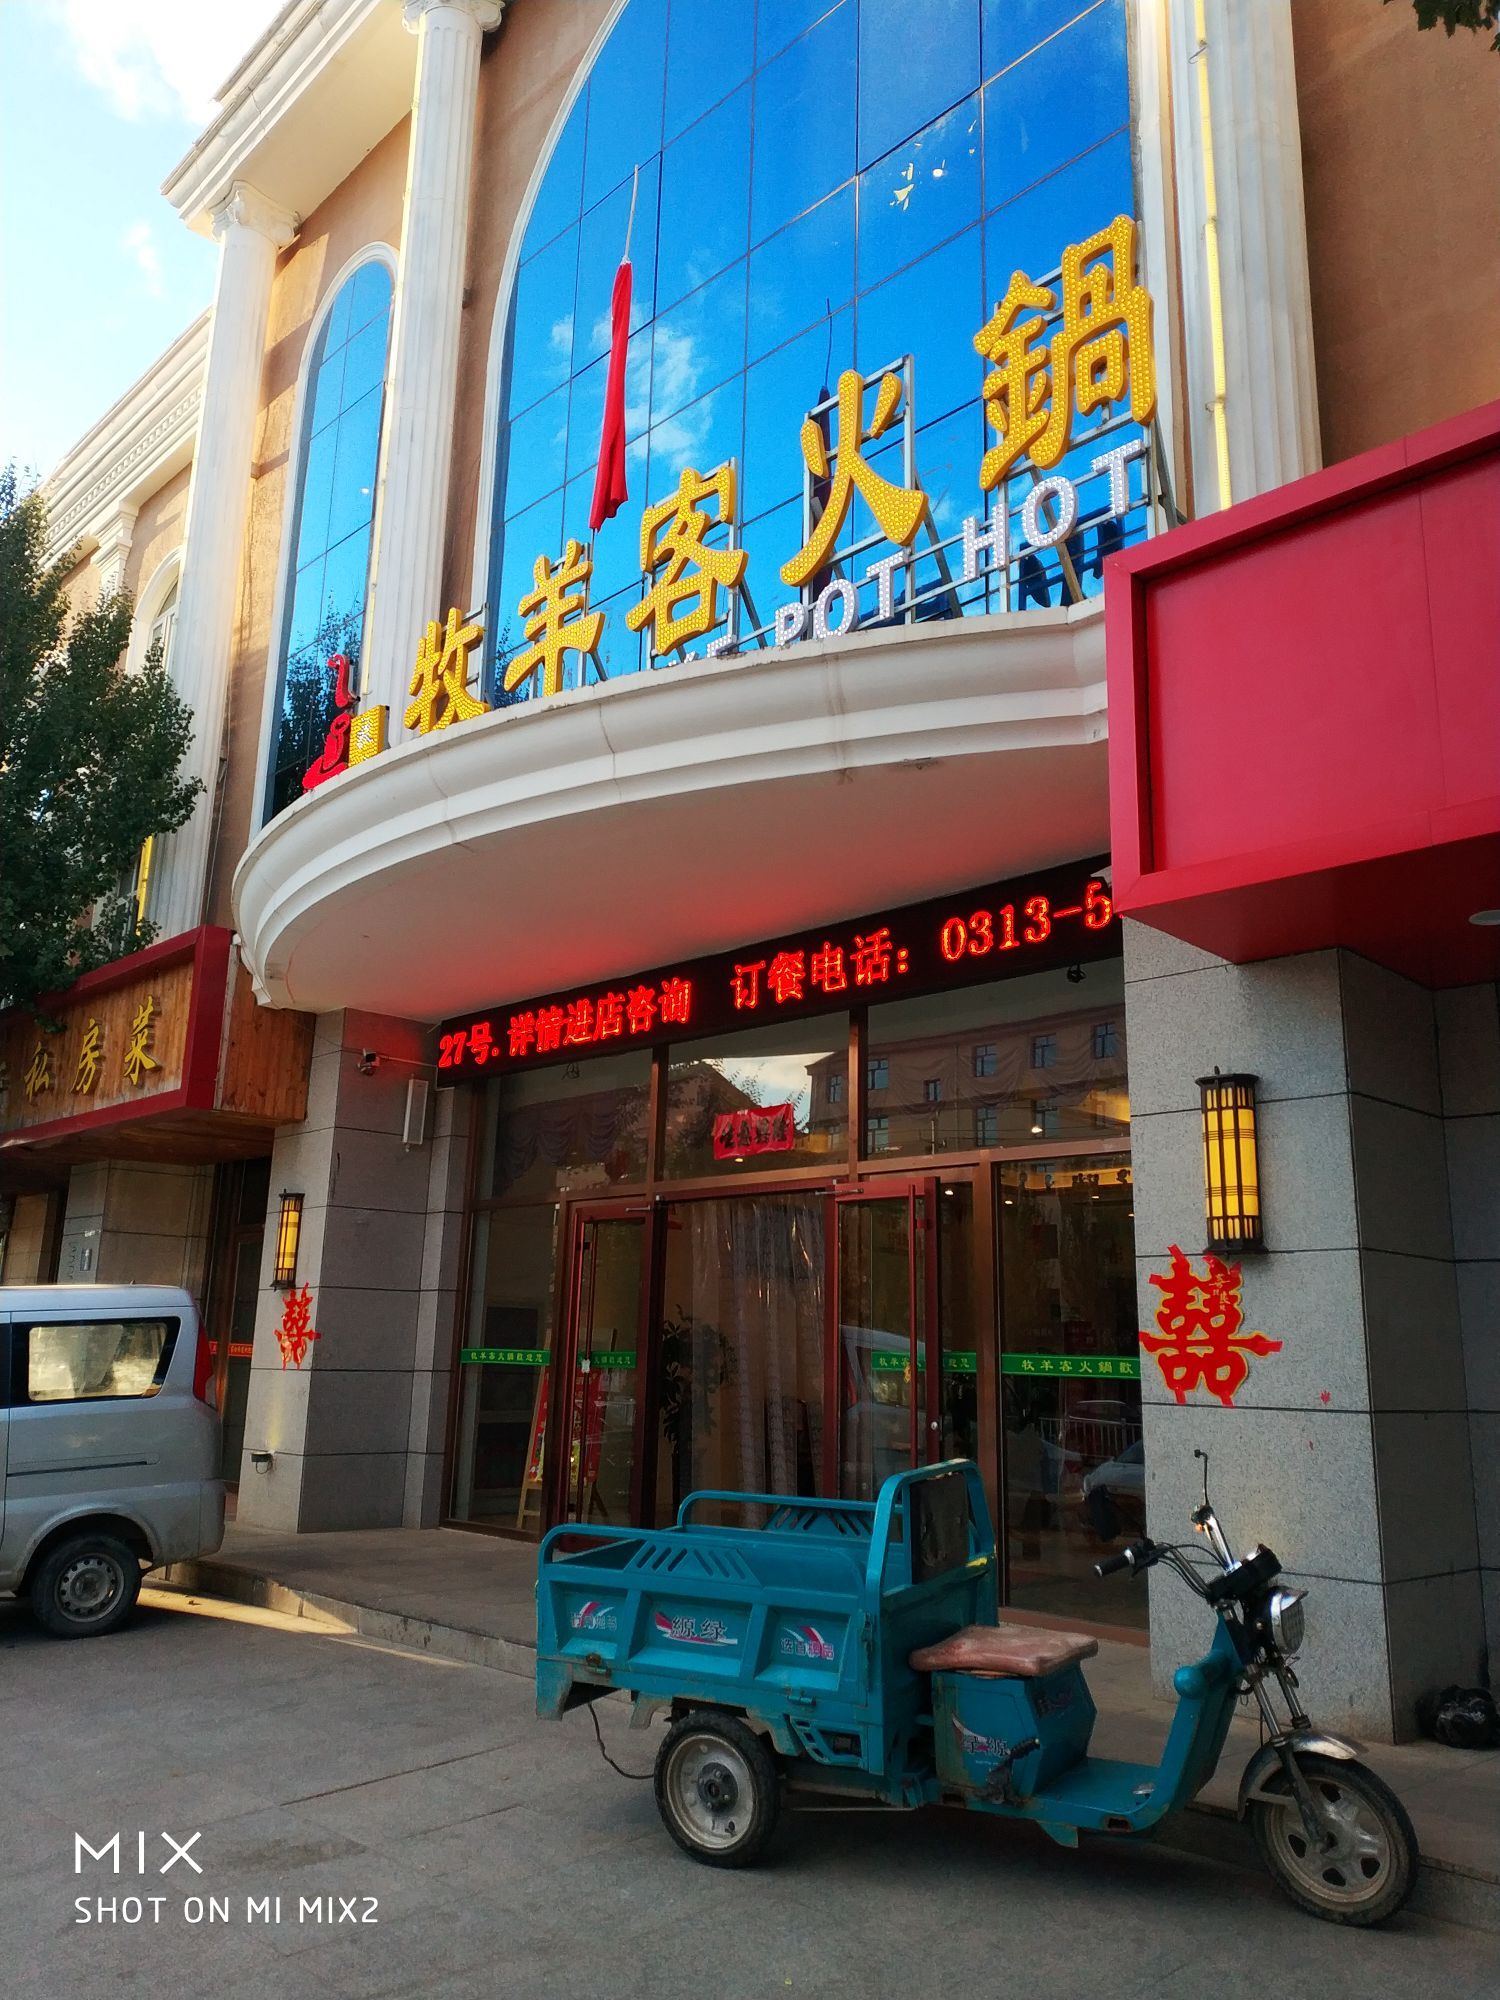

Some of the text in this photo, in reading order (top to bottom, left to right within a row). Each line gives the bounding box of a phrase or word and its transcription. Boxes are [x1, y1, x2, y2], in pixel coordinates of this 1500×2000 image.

[403, 213, 1157, 735] 牧羊客火鍋
[774, 437, 1145, 646] POT HOT
[23, 994, 158, 1102] 私房菜
